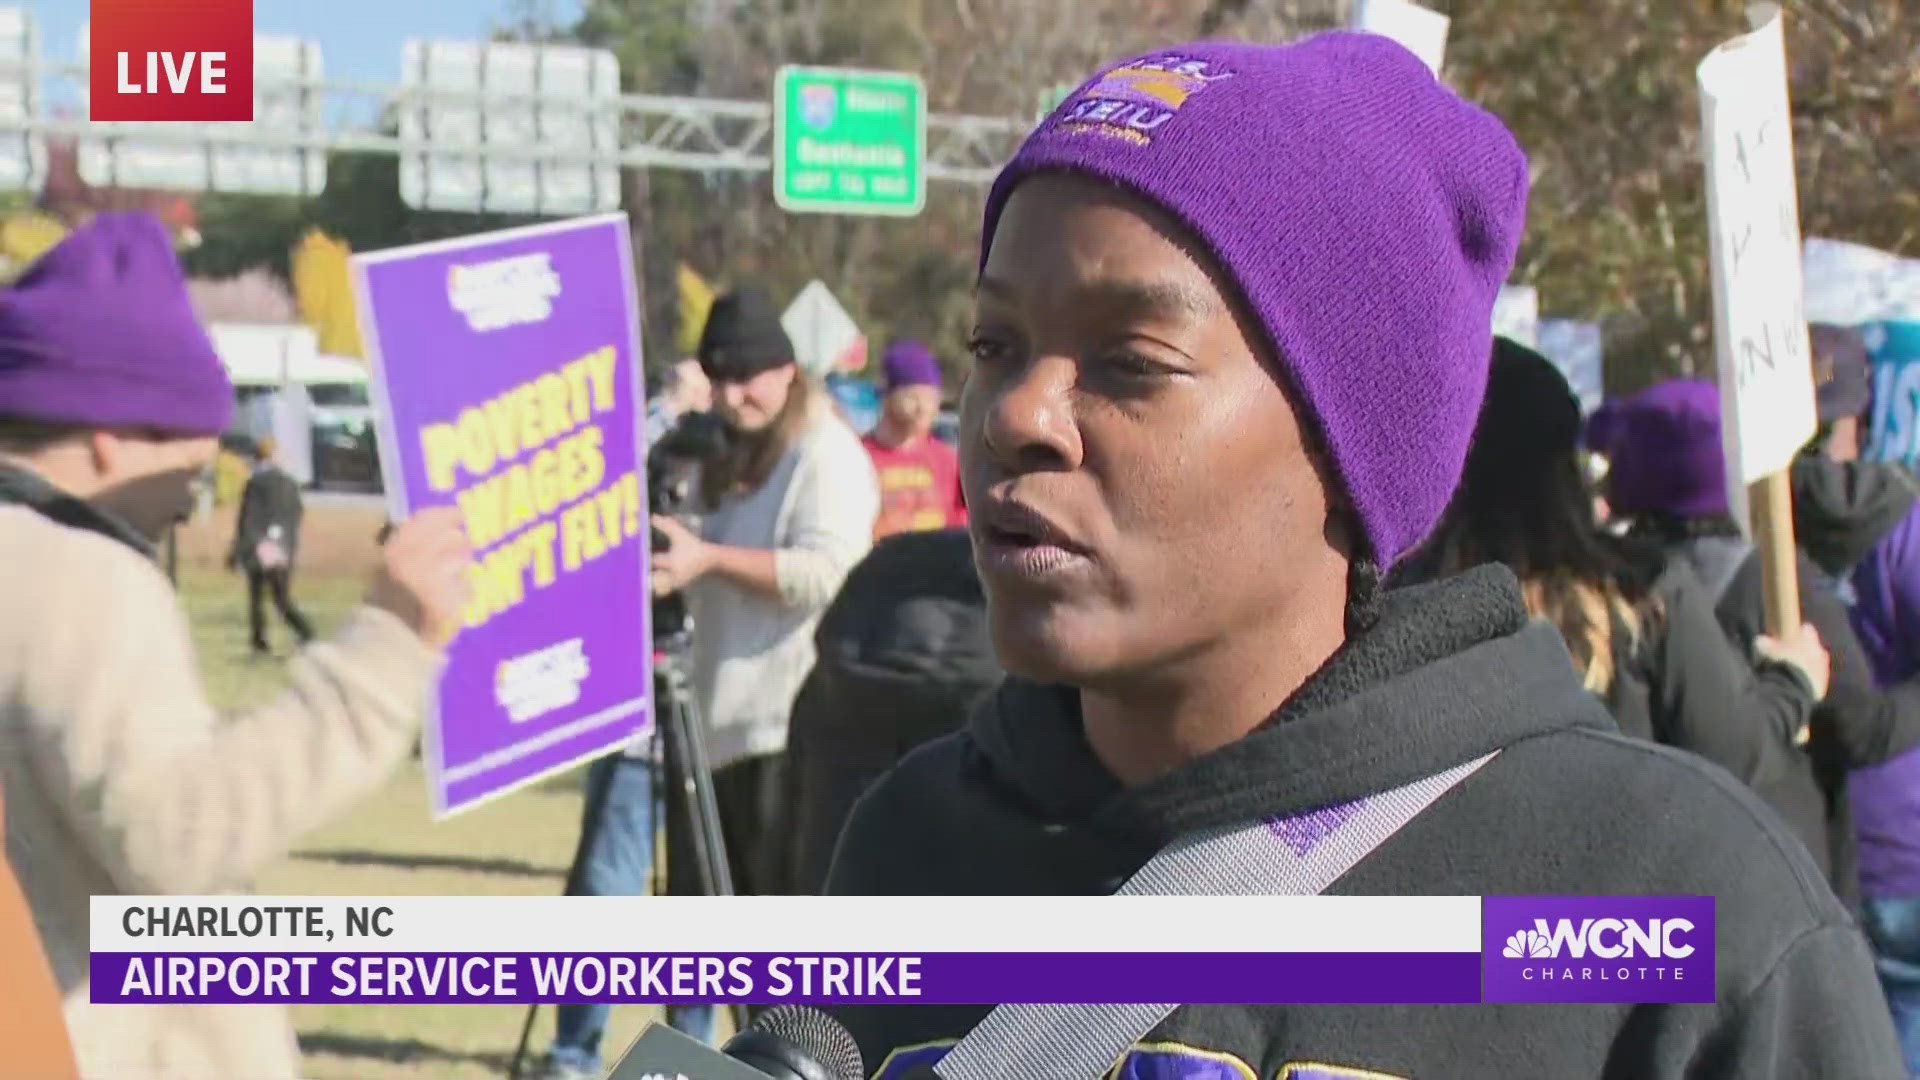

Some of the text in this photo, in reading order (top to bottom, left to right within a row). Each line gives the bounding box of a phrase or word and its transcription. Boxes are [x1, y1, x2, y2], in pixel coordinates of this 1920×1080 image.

[418, 345, 616, 493] POVERTY
[456, 424, 606, 550] WAGES
[560, 471, 641, 572] FLY!
